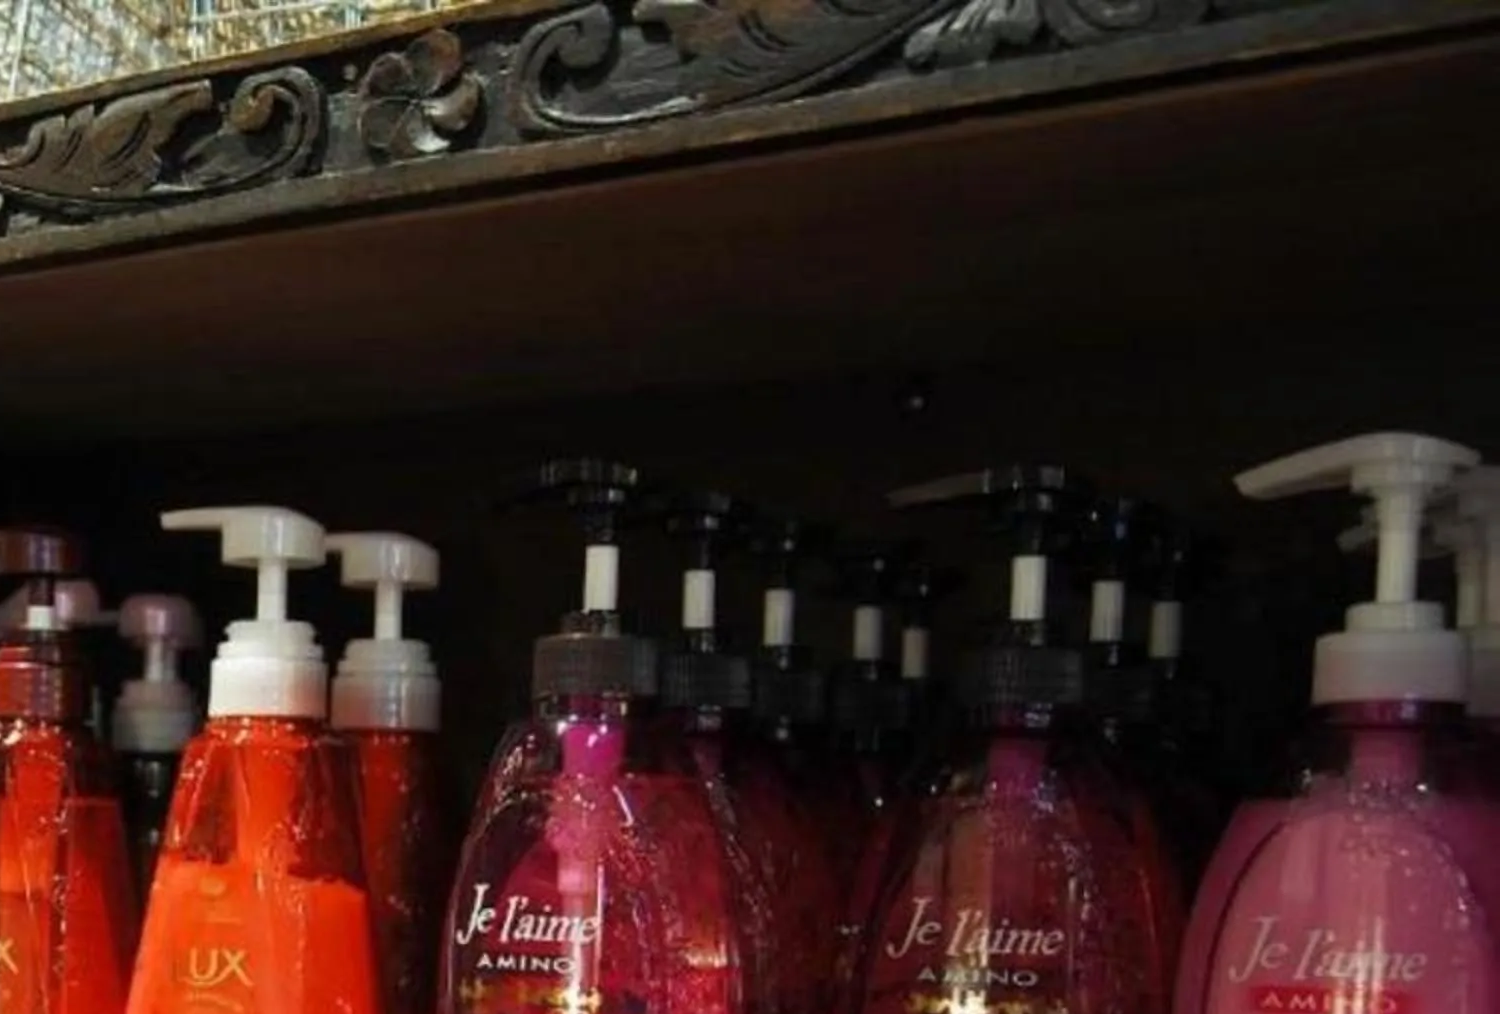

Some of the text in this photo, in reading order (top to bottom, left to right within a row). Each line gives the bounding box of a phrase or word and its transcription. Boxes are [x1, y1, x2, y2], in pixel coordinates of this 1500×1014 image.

[456, 883, 600, 945] Je l'aime
[886, 896, 1064, 959] Je l'aime
[476, 953, 576, 973] AMINO
[917, 966, 1039, 988] AMINO
[1229, 915, 1288, 983] Je
